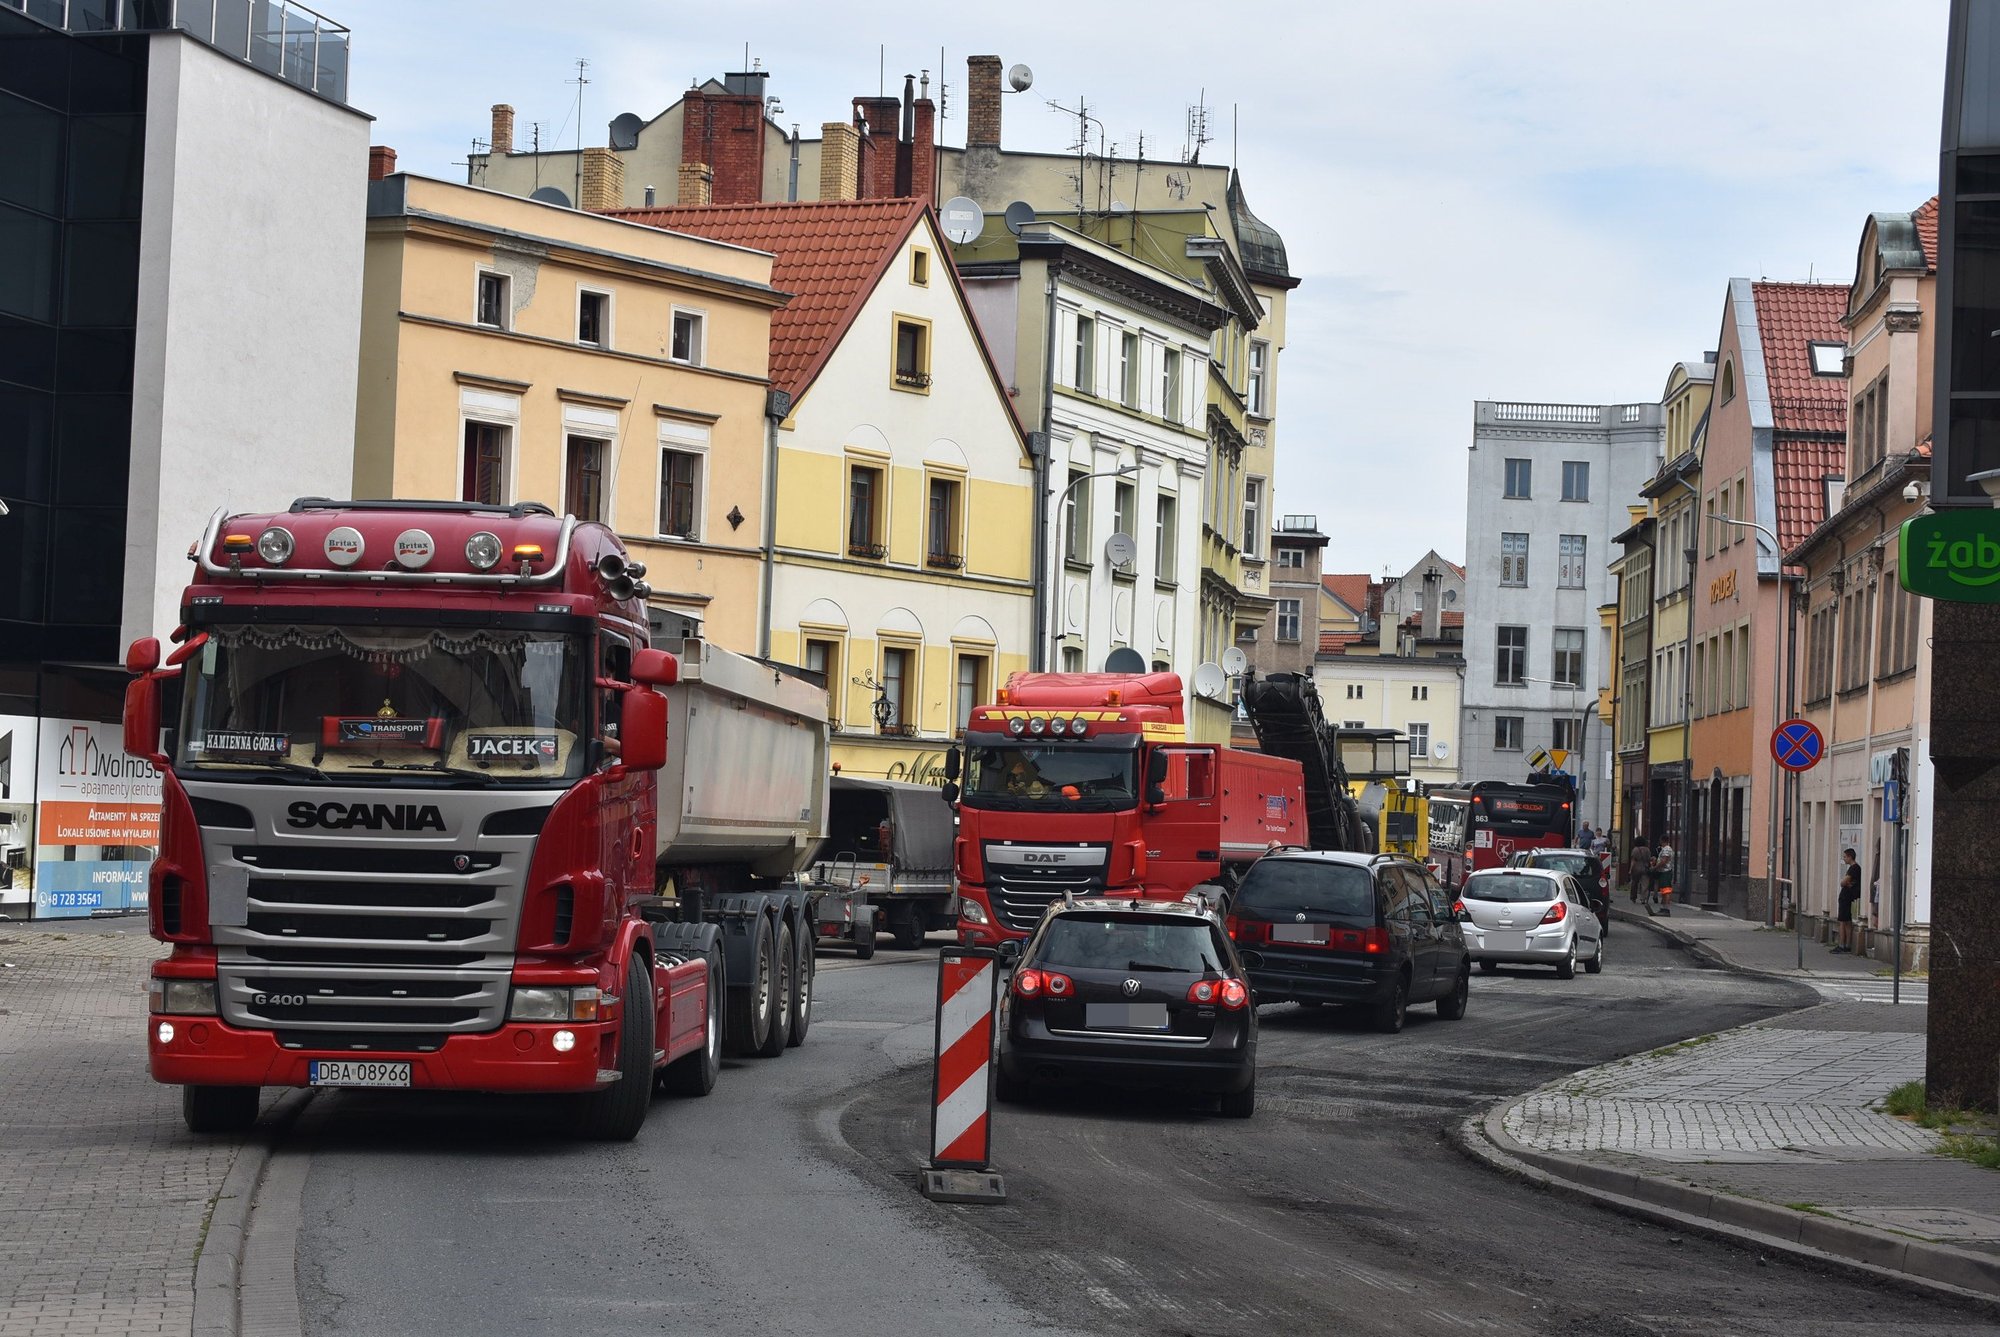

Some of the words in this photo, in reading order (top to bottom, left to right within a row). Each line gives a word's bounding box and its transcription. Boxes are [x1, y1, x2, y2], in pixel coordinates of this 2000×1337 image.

[1710, 569, 1736, 605] RADEX
[207, 734, 251, 750] KAMIENNA
[253, 732, 275, 751] GÓRA
[472, 739, 540, 755] JACEK
[287, 801, 447, 831] SCANIA
[58, 824, 83, 837] LOKALE
[111, 828, 121, 838] NA
[1023, 853, 1066, 862] DAF
[60, 893, 75, 905] 728
[255, 994, 267, 1004] G
[270, 995, 304, 1005] 400
[320, 1063, 351, 1080] DBA
[357, 1064, 408, 1081] 08966
